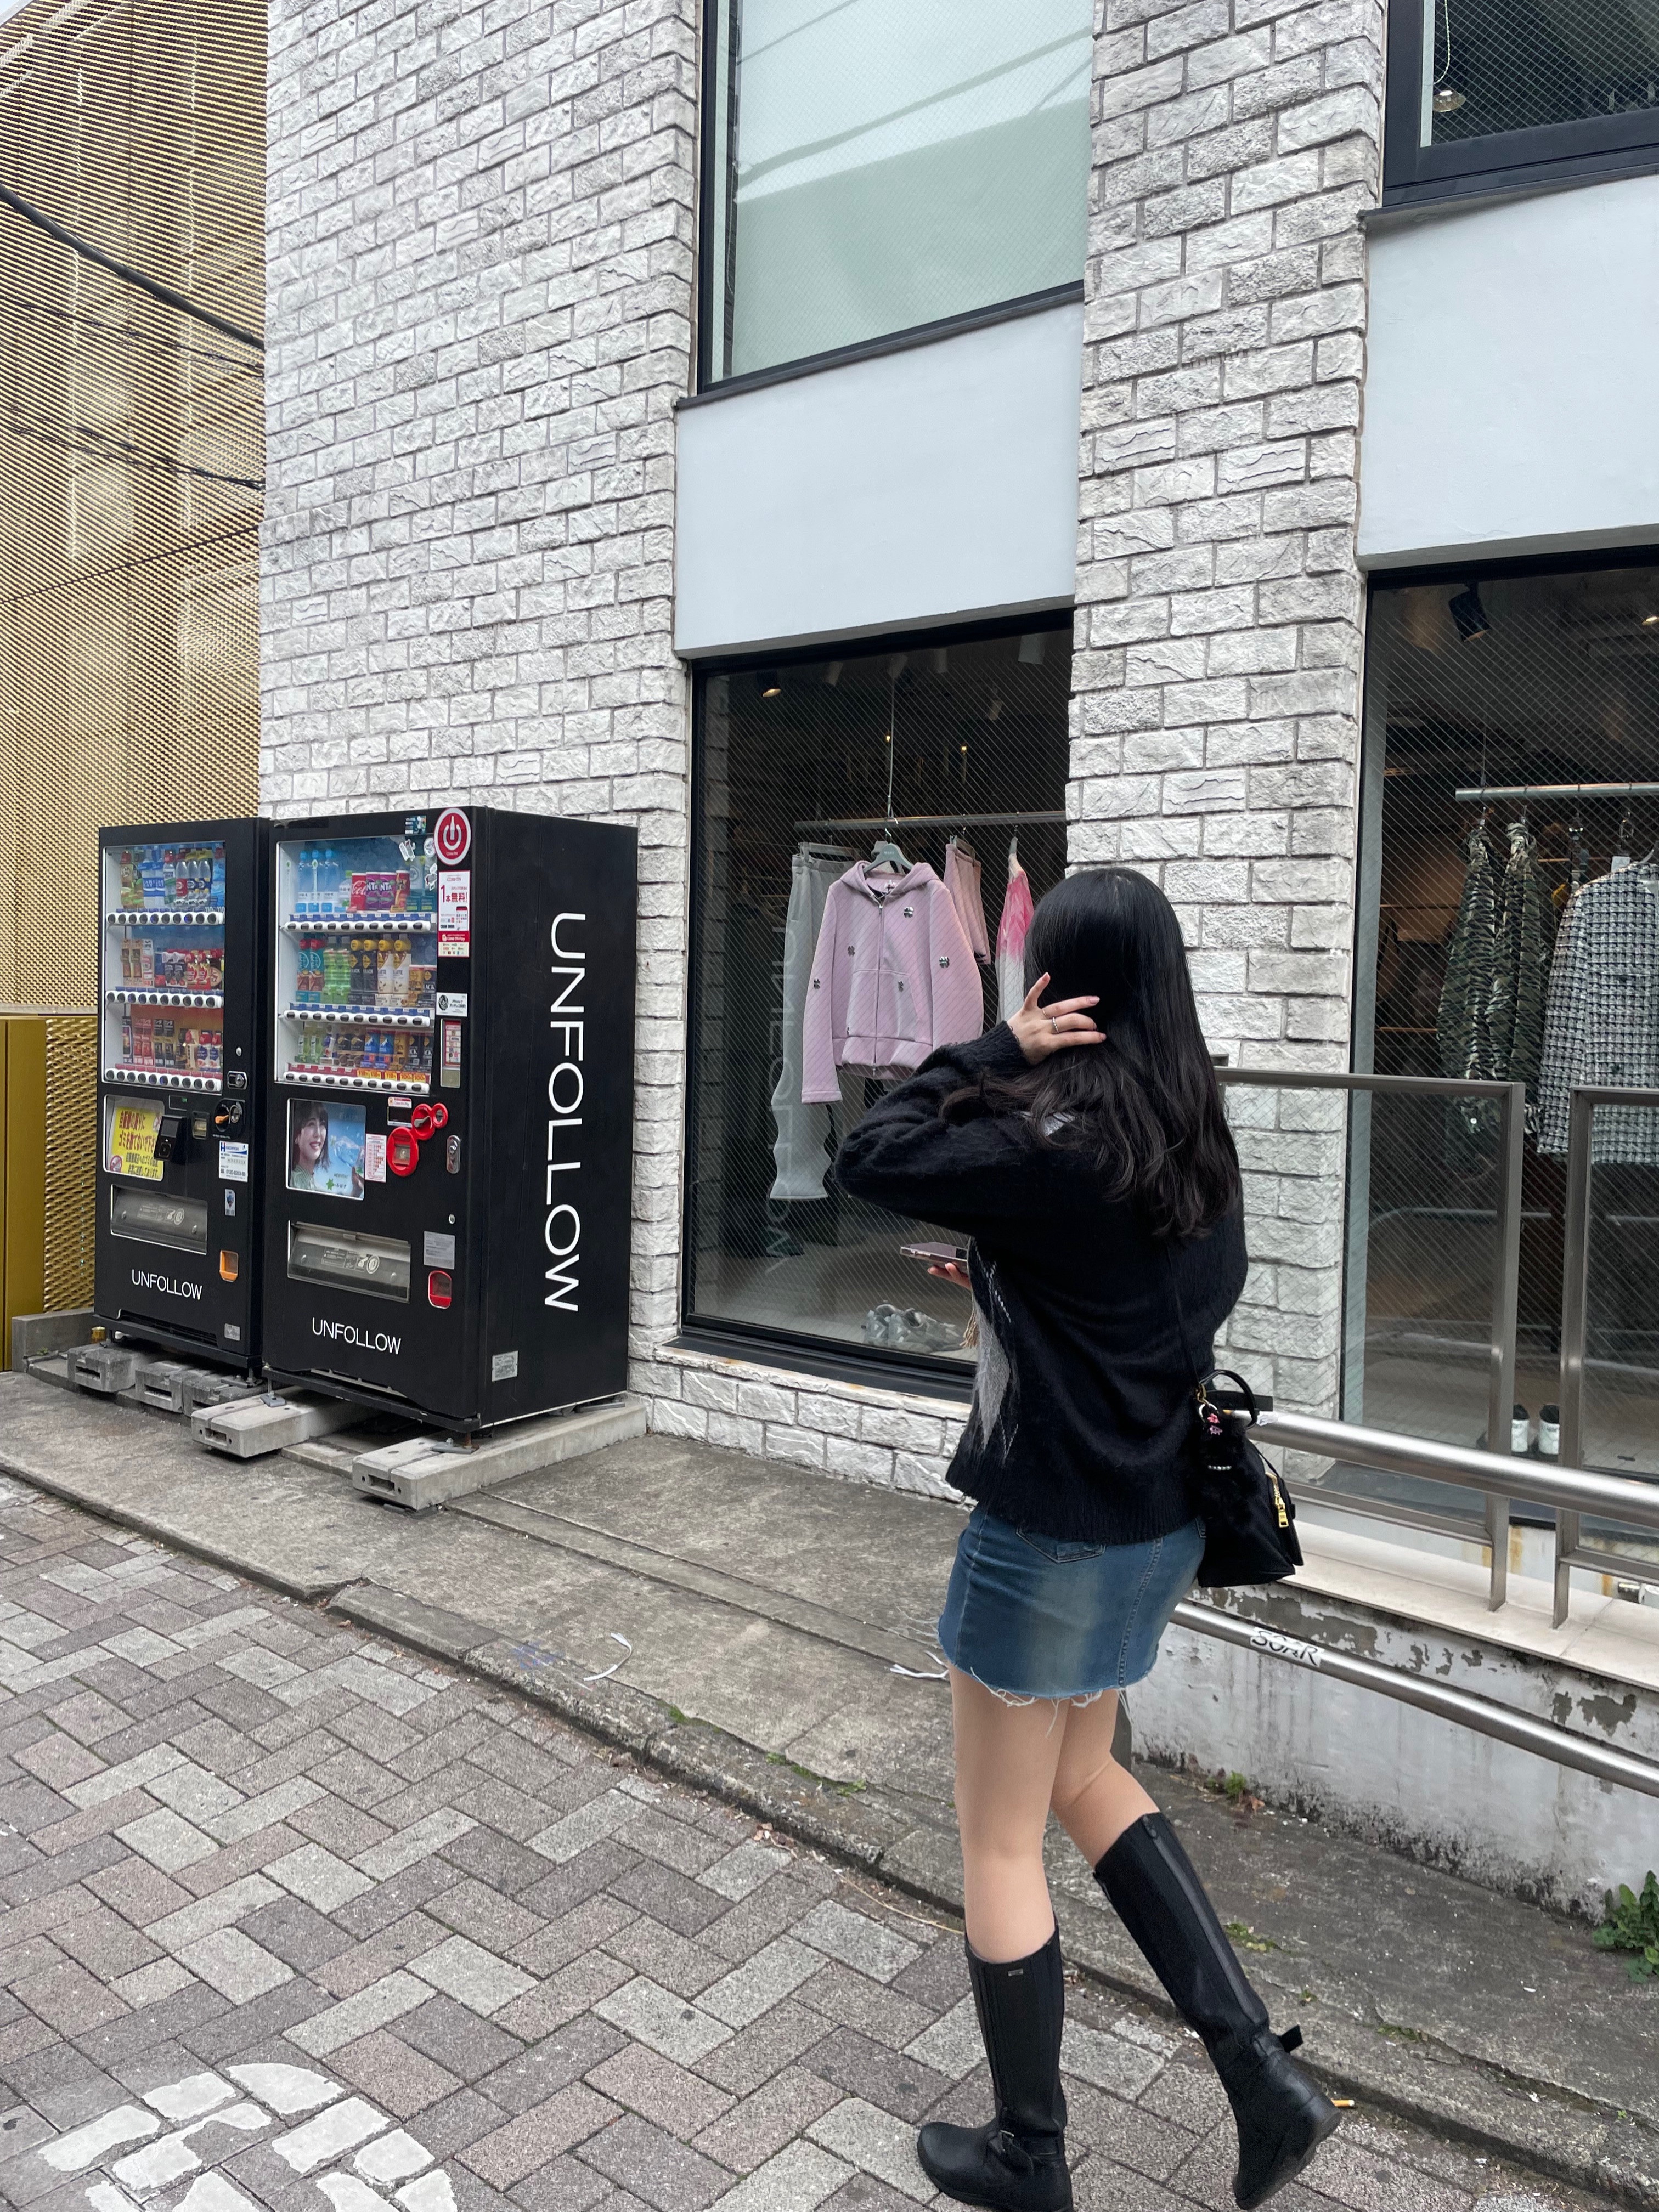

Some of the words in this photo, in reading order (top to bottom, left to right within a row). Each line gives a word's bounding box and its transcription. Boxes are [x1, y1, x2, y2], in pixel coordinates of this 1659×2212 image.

[544, 913, 586, 1311] UNFOLLOW
[132, 1269, 202, 1300] UNFOLLOW
[312, 1317, 402, 1355] UNFOLLOW
